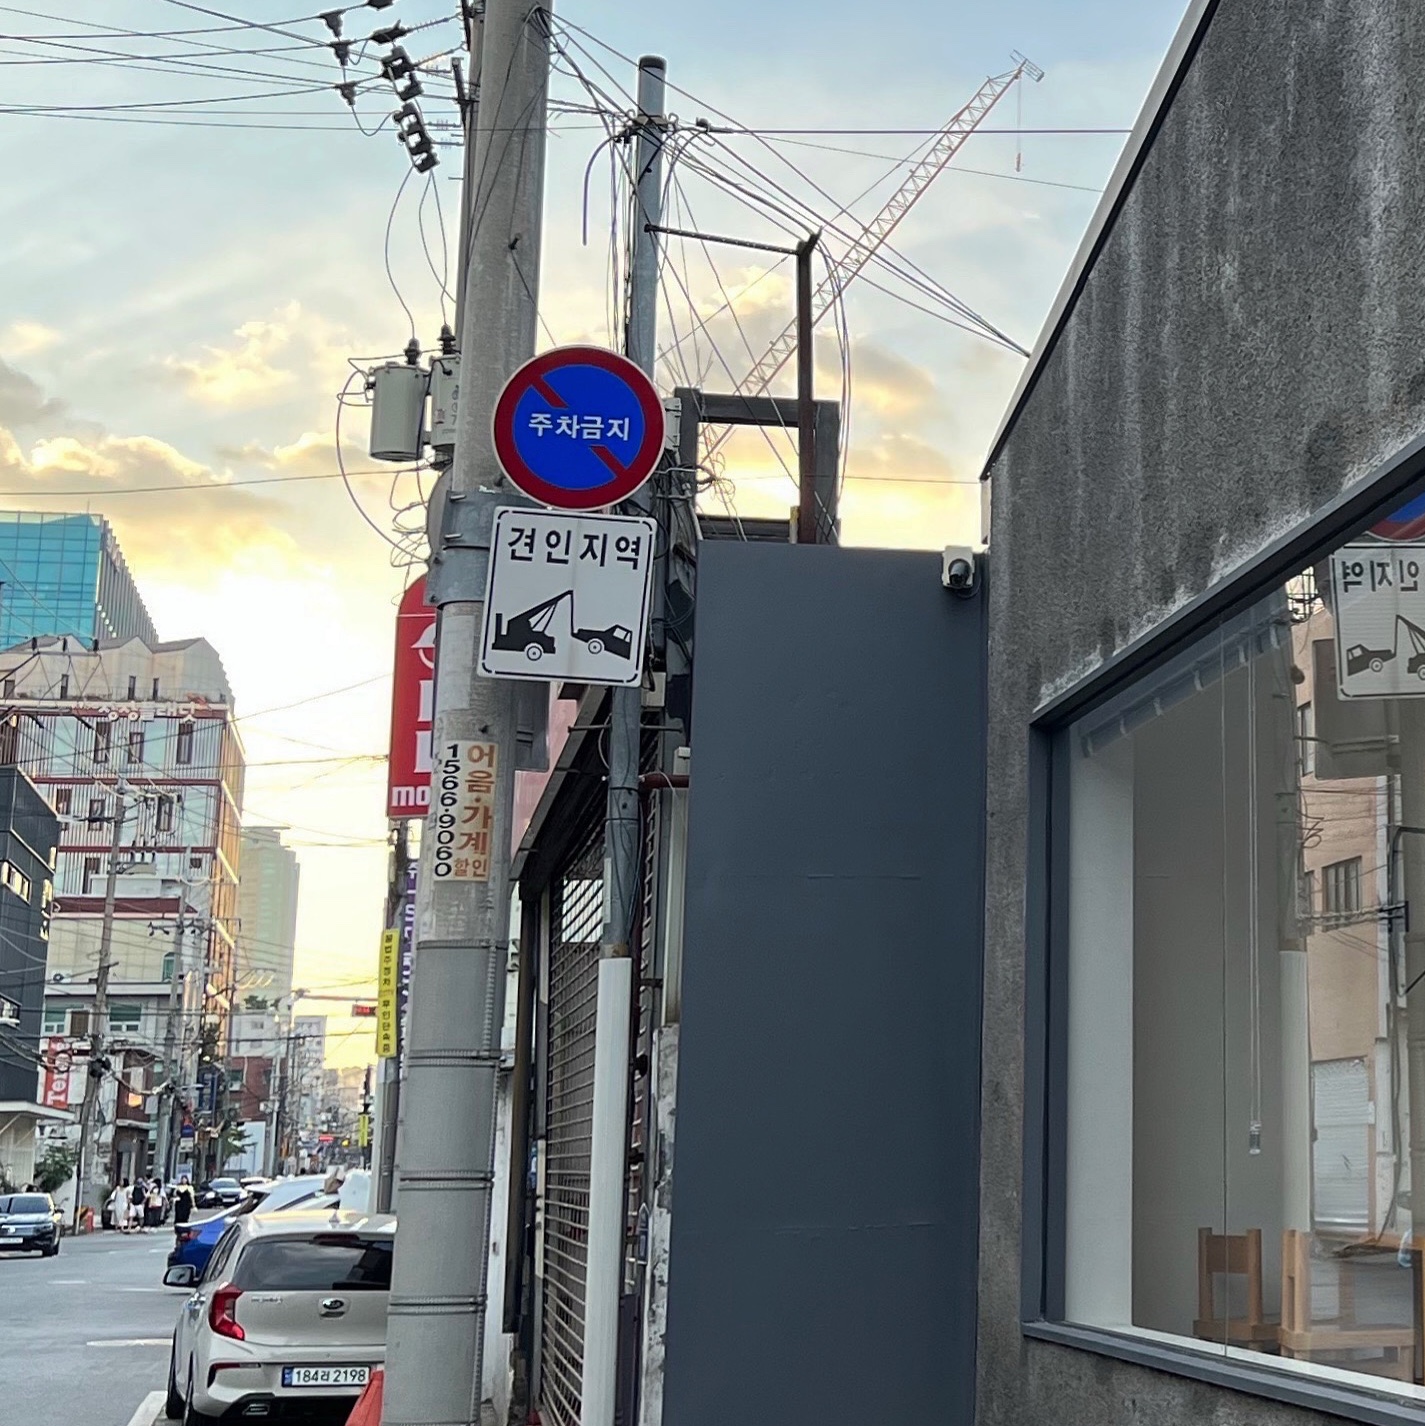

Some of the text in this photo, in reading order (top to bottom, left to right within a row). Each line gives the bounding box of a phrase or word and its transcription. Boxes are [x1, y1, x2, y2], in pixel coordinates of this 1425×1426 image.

[528, 413, 630, 441] 주차금지
[507, 526, 641, 571] 견인지역
[454, 858, 487, 877] 할인
[333, 1368, 367, 1383] 2198
